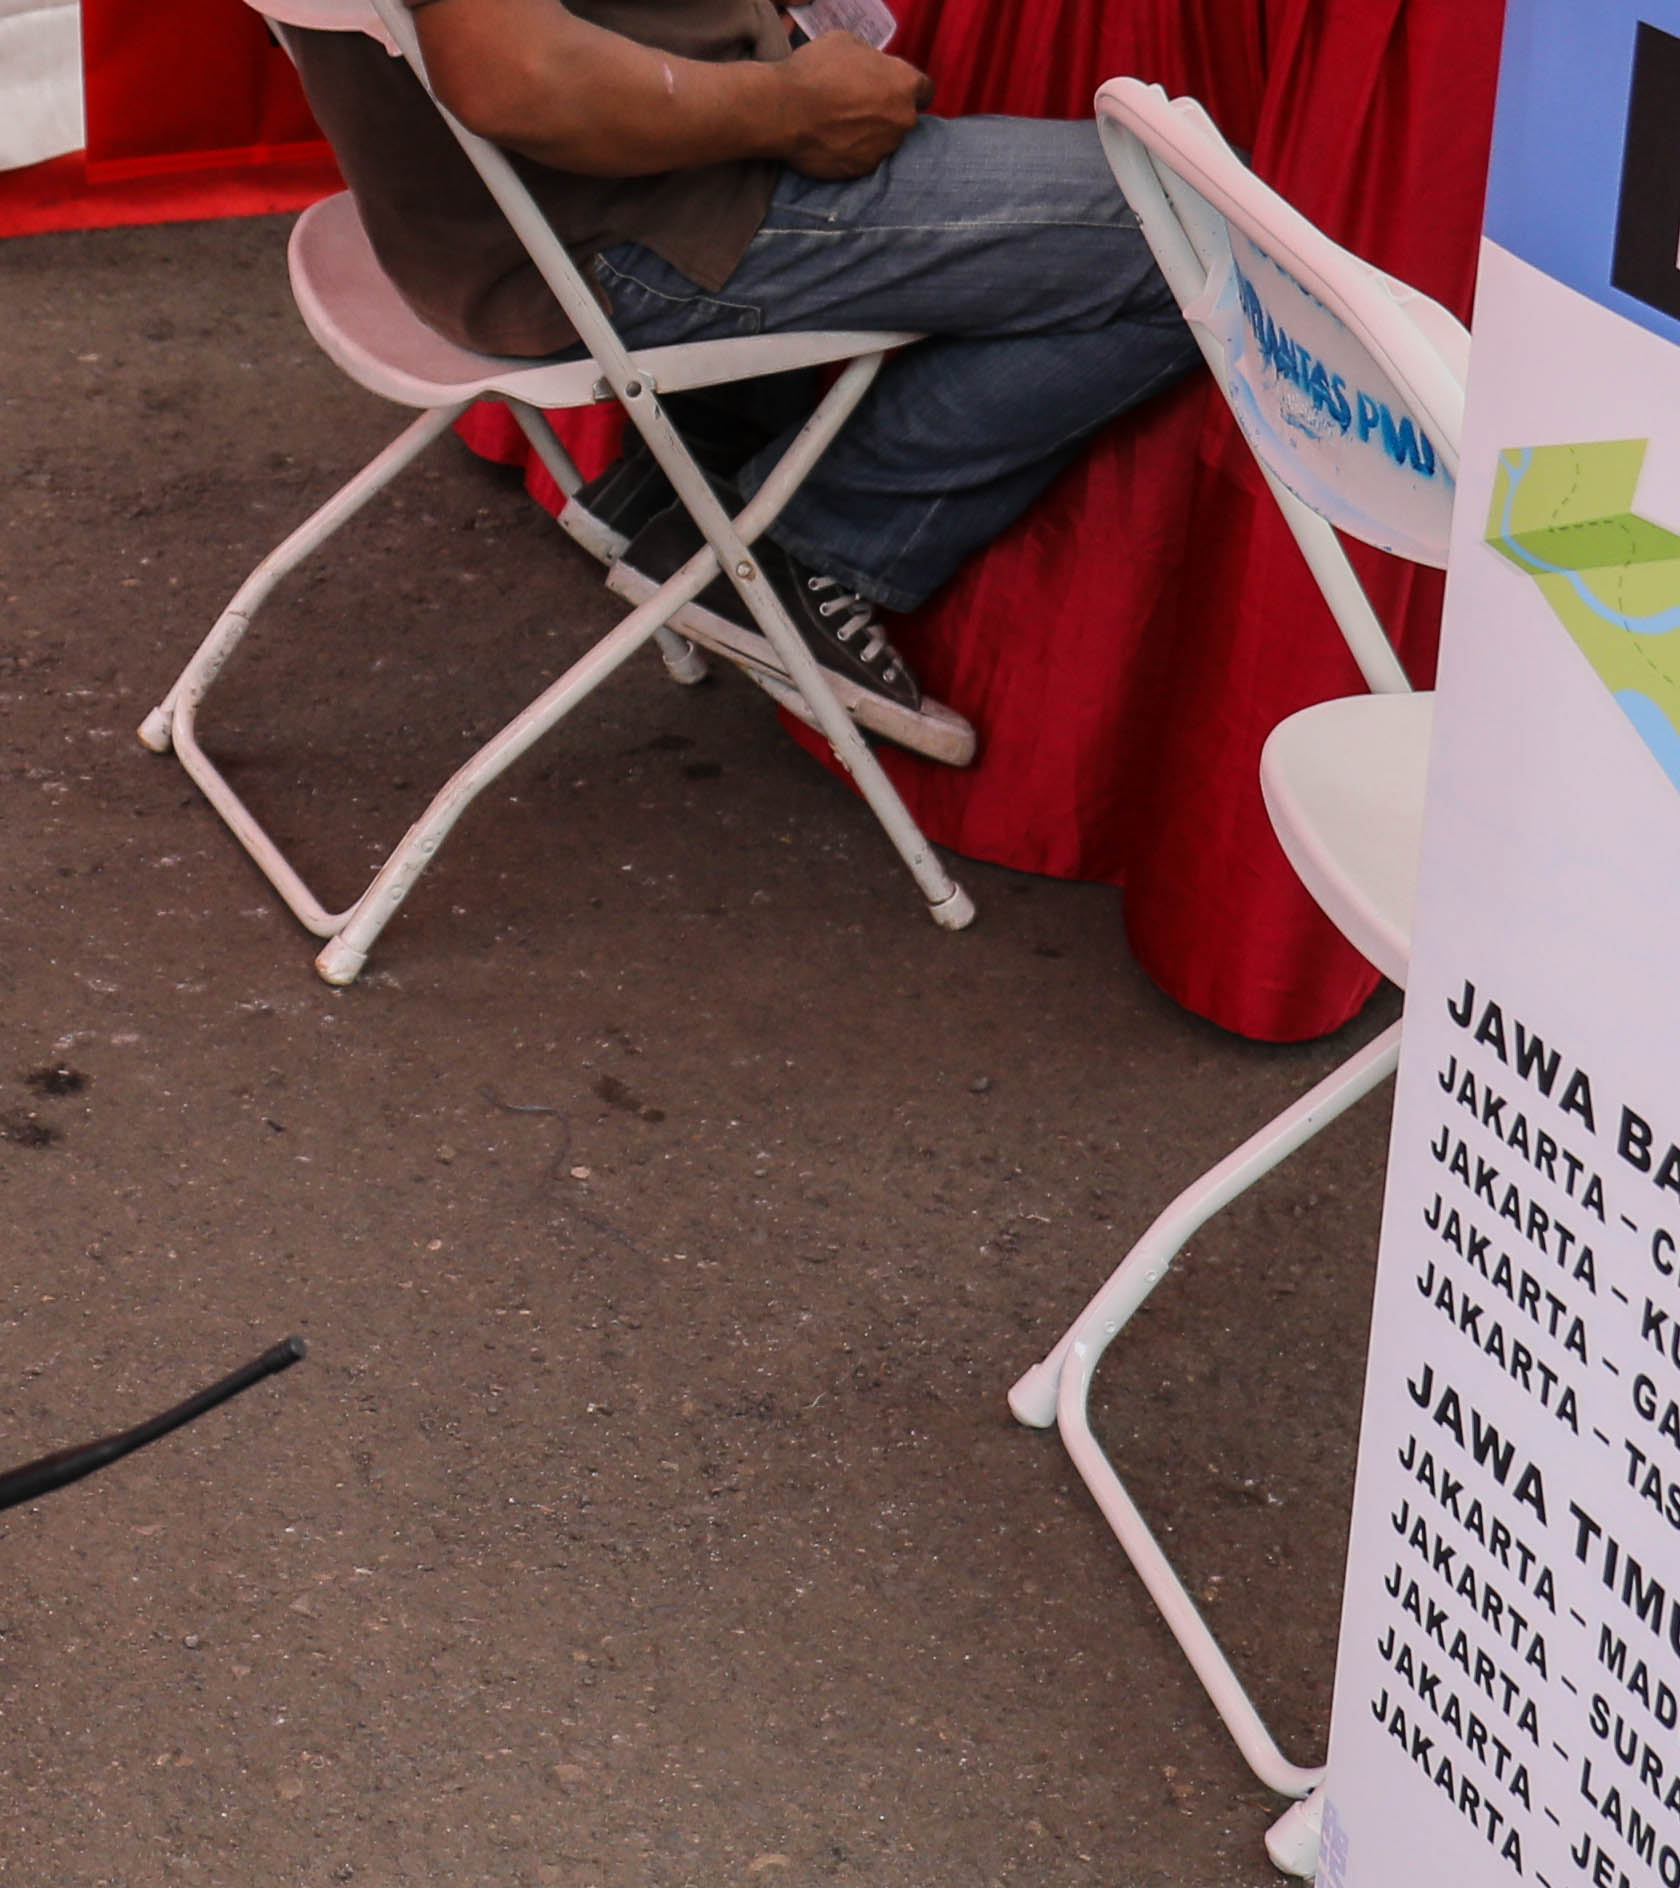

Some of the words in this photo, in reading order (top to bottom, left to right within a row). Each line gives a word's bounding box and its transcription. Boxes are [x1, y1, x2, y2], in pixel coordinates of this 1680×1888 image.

[1438, 1055, 1606, 1223] JAKARTA
[1447, 979, 1596, 1134] JAWA
[1423, 1193, 1588, 1365] JAKARTA
[1431, 1125, 1597, 1295] JAKARTA
[1417, 1261, 1579, 1435] JAKARTA
[1398, 1435, 1556, 1615] JAKARTA
[1407, 1363, 1548, 1527] JAWA
[1384, 1563, 1539, 1747] JAKARTA
[1391, 1499, 1548, 1681] JAKARTA
[1371, 1688, 1523, 1876] JAKARTA
[1377, 1626, 1531, 1812] JAKARTA
